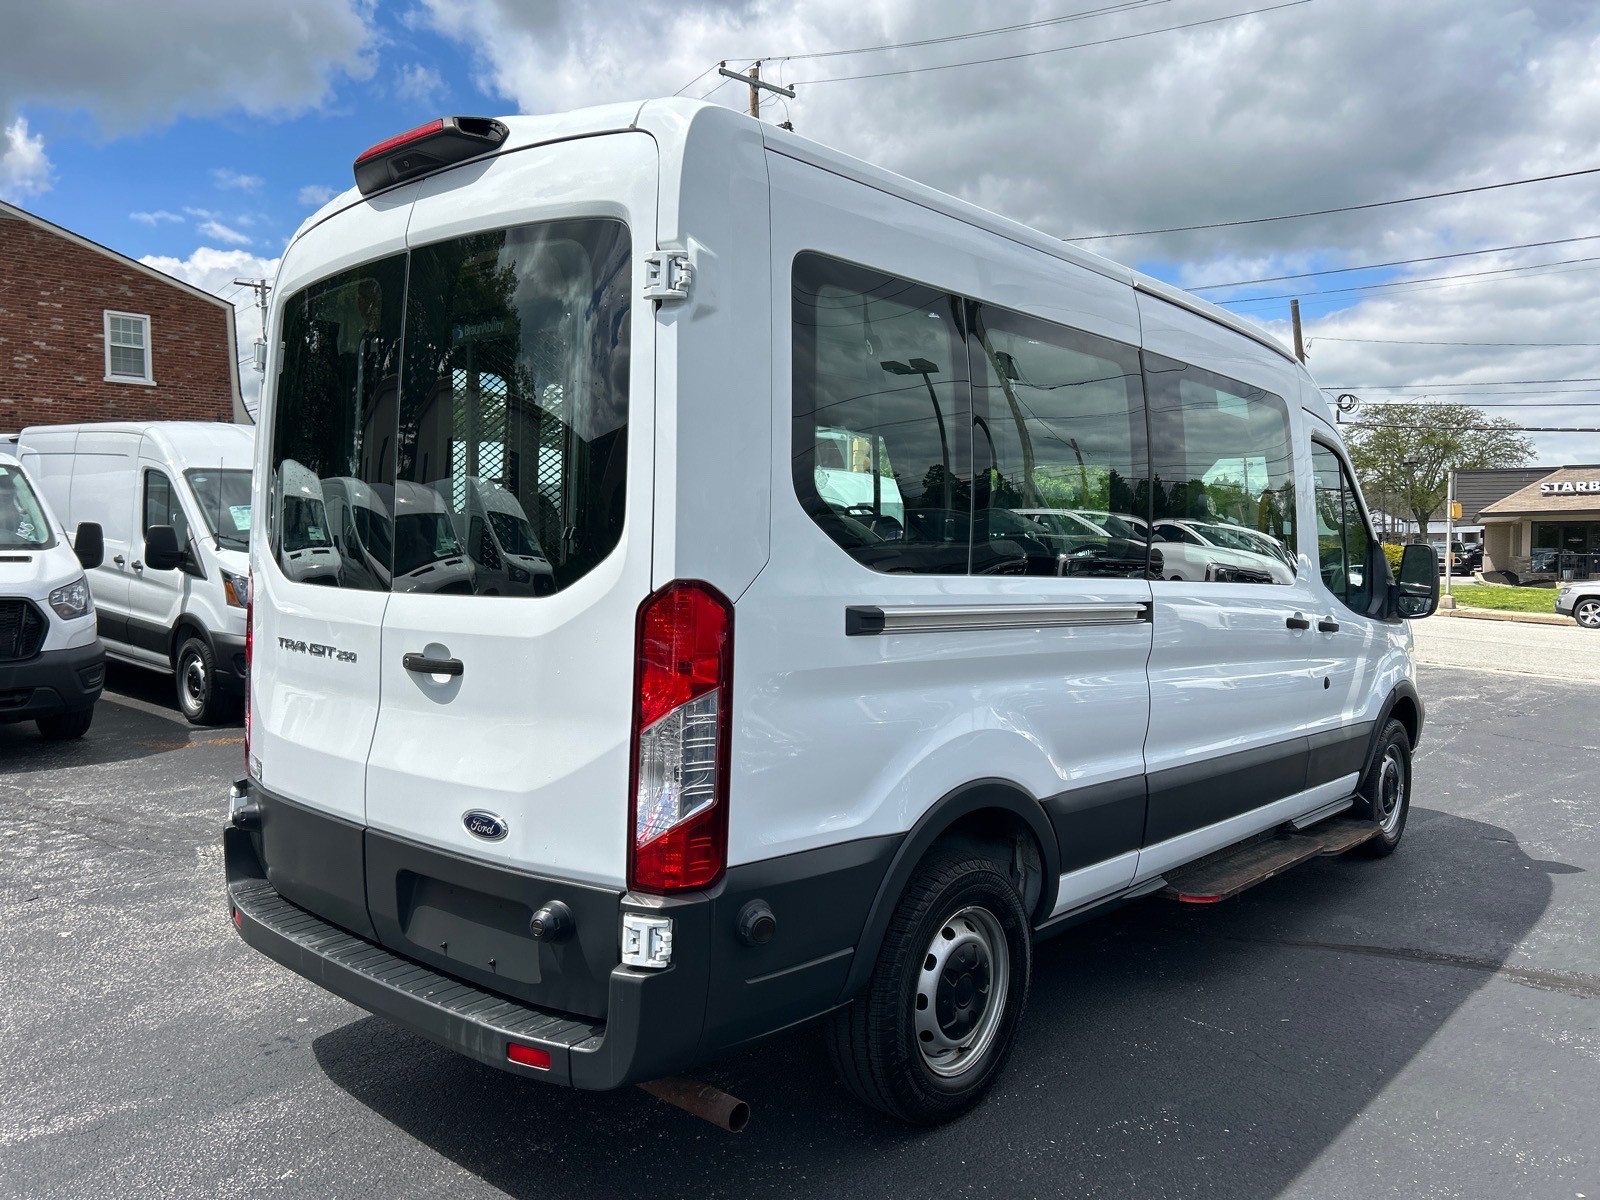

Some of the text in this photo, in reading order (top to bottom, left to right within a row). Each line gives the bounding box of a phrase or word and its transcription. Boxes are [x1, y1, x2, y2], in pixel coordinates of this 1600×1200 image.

[1540, 481, 1600, 493] STARB
[277, 636, 337, 660] TRANSIT
[470, 816, 495, 835] Ford
